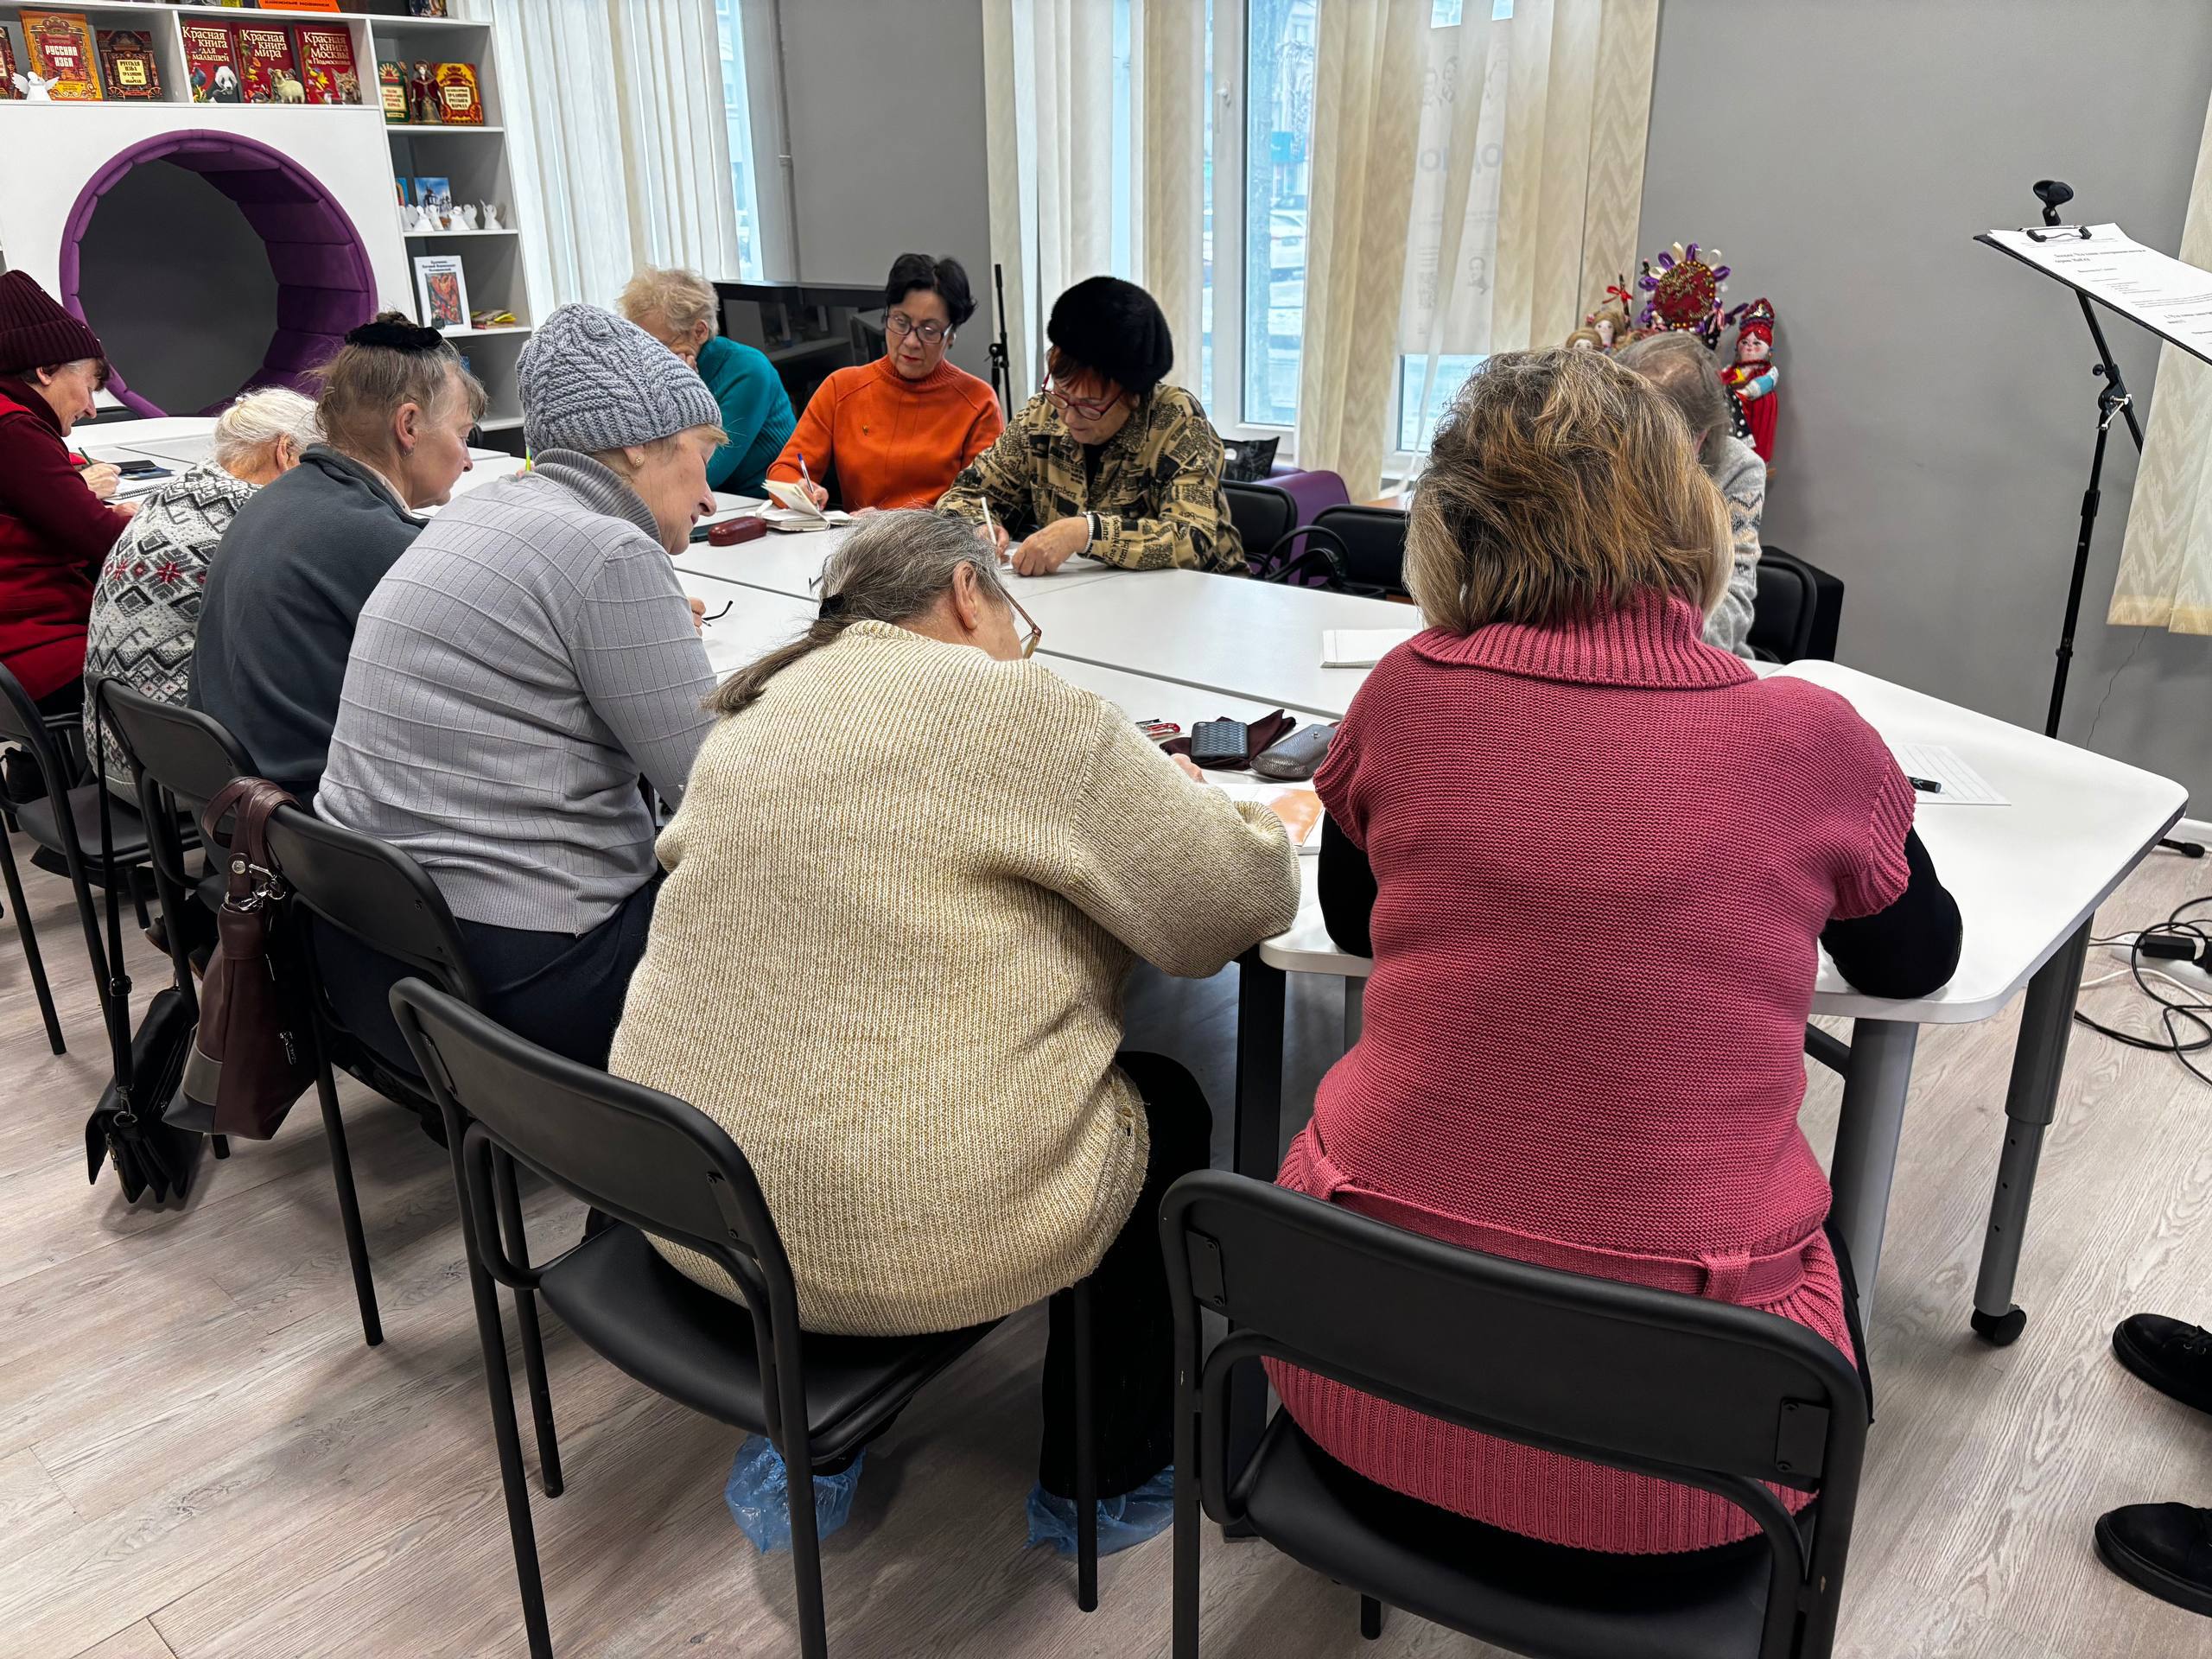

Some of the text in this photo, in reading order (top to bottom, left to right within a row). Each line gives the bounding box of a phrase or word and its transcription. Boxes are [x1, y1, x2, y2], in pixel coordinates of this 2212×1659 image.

[181, 27, 226, 41] Красная
[242, 29, 285, 44] Красная
[303, 32, 346, 46] Красная
[198, 39, 228, 48] книга
[257, 41, 288, 50] книга
[319, 43, 348, 52] книга
[45, 45, 79, 56] РУССКАЯ
[254, 49, 283, 60] мира
[311, 48, 349, 60] Москвы
[54, 57, 74, 67] ИЗБА
[192, 53, 230, 62] малышей
